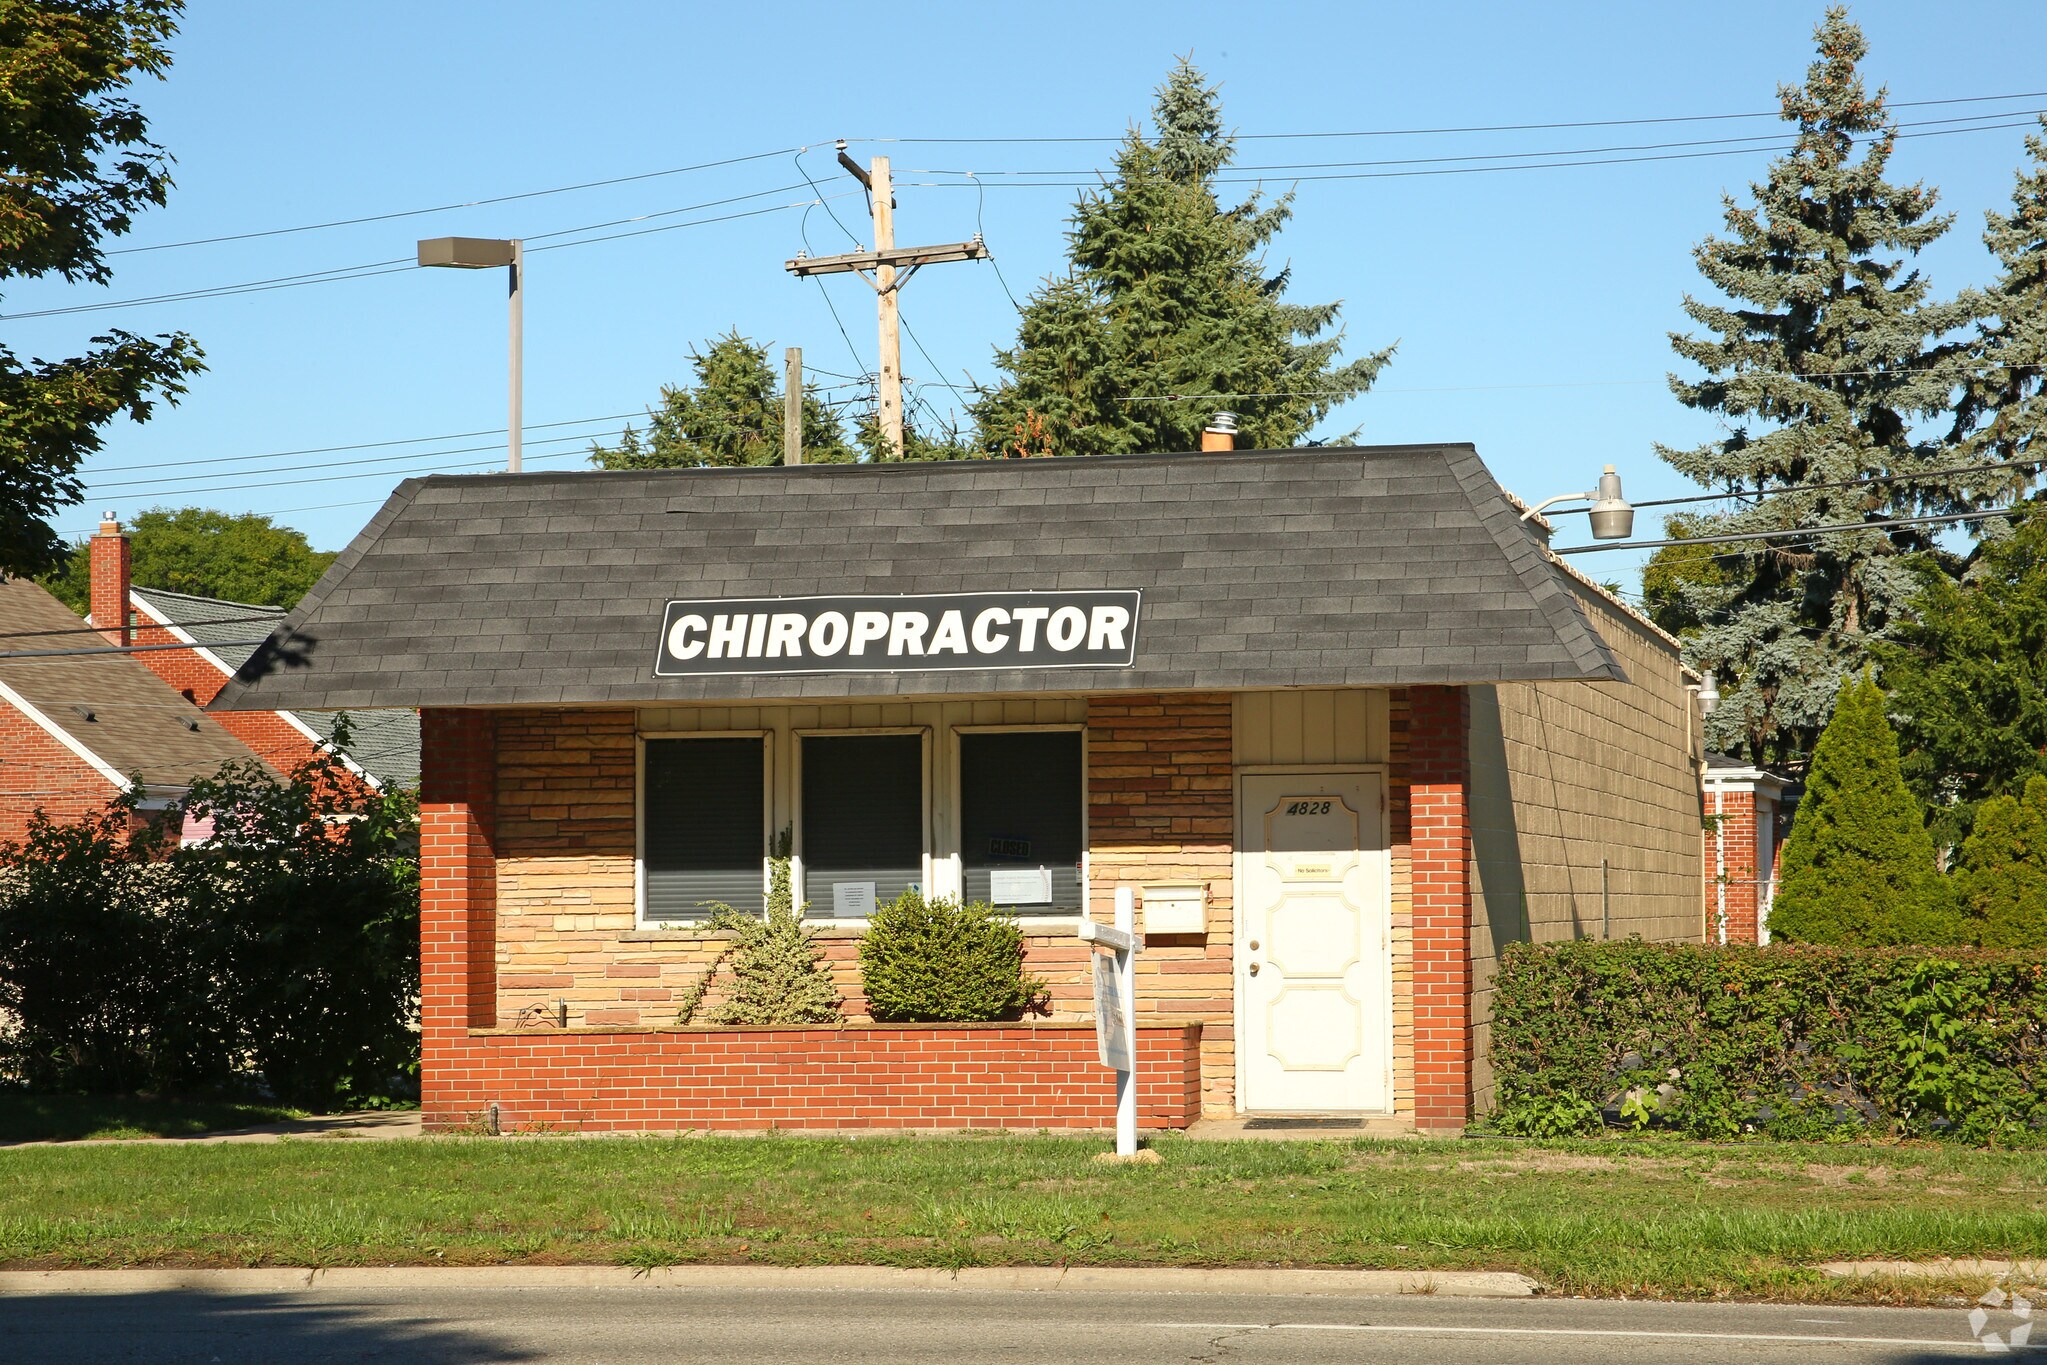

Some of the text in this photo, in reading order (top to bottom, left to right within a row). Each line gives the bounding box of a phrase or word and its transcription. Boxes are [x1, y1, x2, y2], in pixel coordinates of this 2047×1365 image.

[667, 605, 1130, 661] CHIROPRACTOR
[1286, 801, 1331, 816] 4828
[991, 839, 1029, 857] CLOSED
